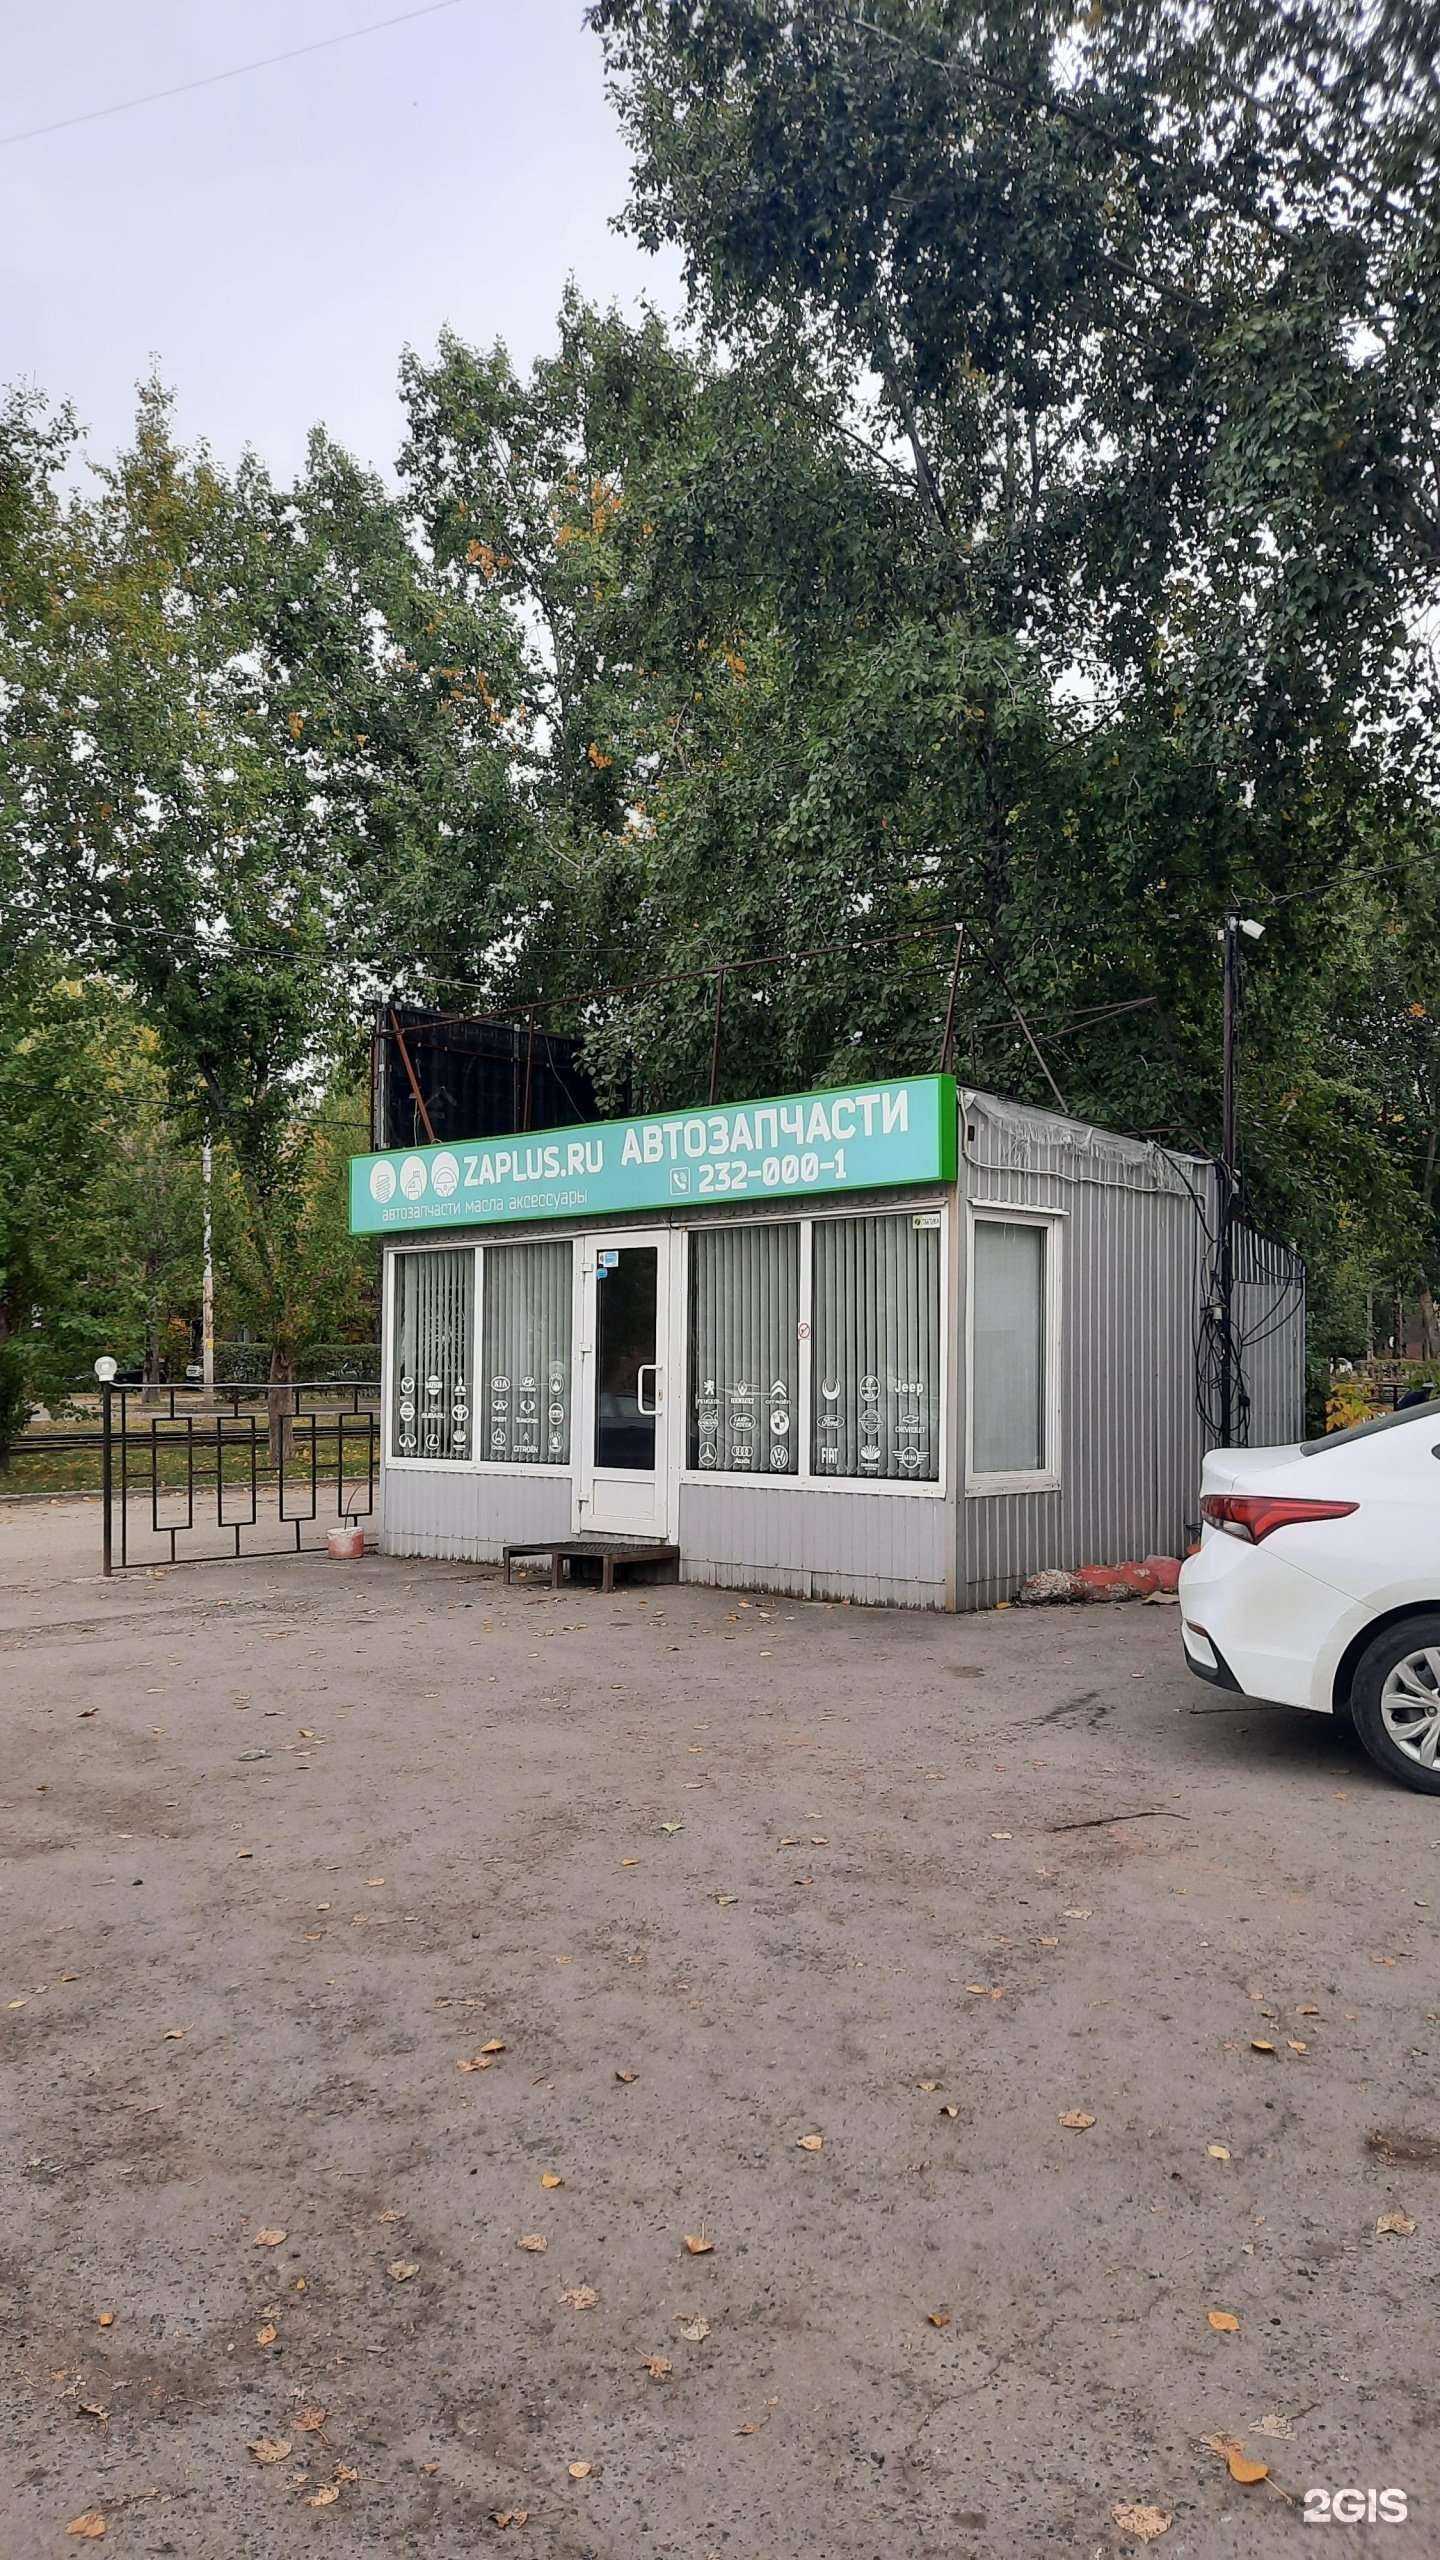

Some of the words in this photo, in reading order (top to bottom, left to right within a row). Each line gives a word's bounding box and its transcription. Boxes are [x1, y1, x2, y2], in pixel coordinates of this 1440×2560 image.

[620, 1089, 909, 1166] АВТОЗАПЧАСТИ
[462, 1139, 604, 1187] ZAPLUS.RU
[698, 1148, 848, 1193] 232-000-1
[382, 1204, 462, 1222] автозапчасти
[465, 1198, 505, 1213] масла
[508, 1190, 588, 1211] аксессуары
[494, 1379, 508, 1388] KIA
[894, 1379, 924, 1397] Jeep
[821, 1447, 839, 1464] FIAT
